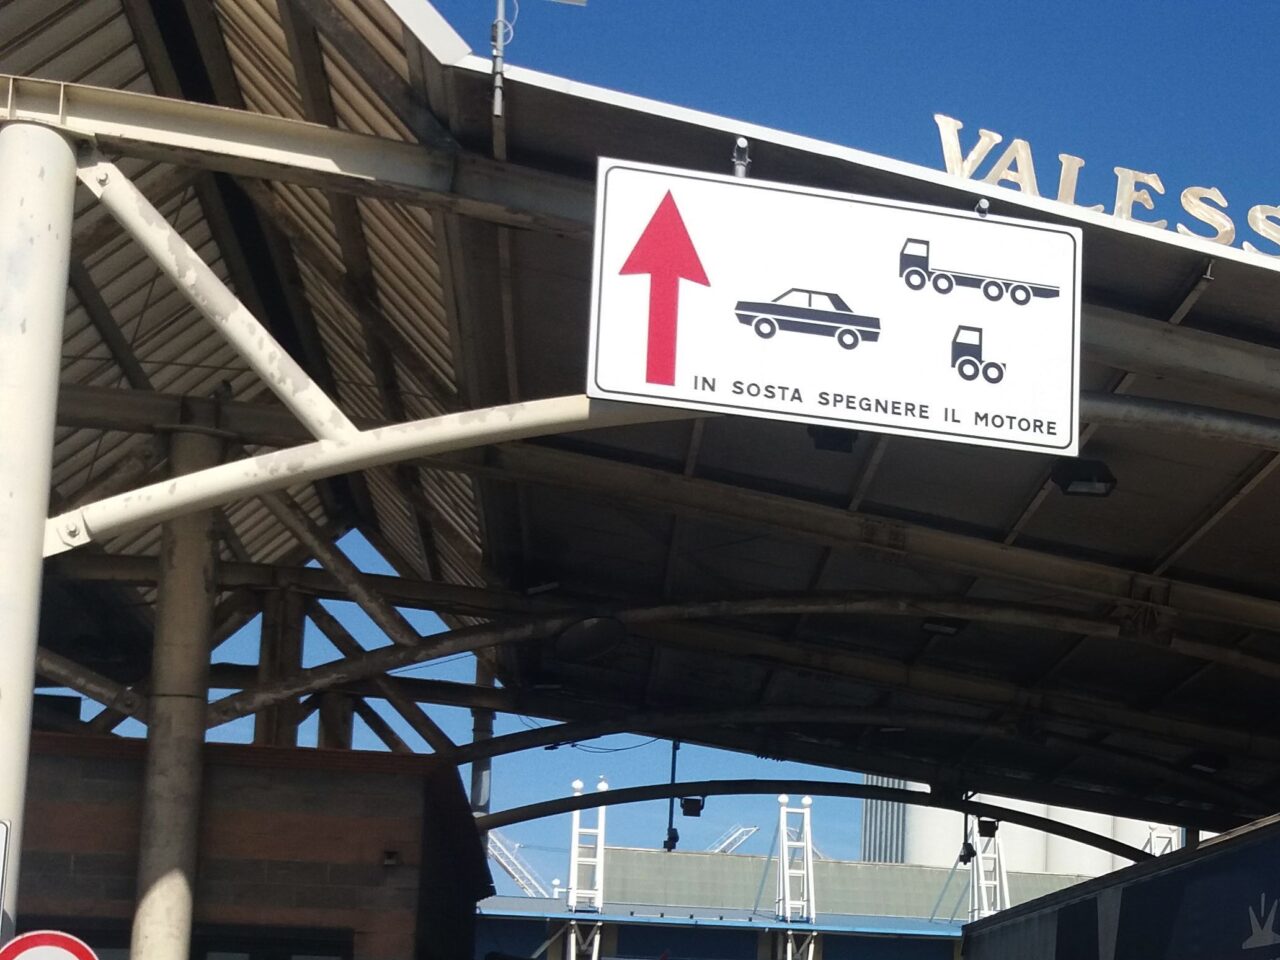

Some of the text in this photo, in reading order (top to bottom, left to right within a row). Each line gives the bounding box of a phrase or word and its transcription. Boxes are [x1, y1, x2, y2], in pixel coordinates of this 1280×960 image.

[693, 375, 1058, 436] IN SOSTA SPEGNERE IL MOTORE
